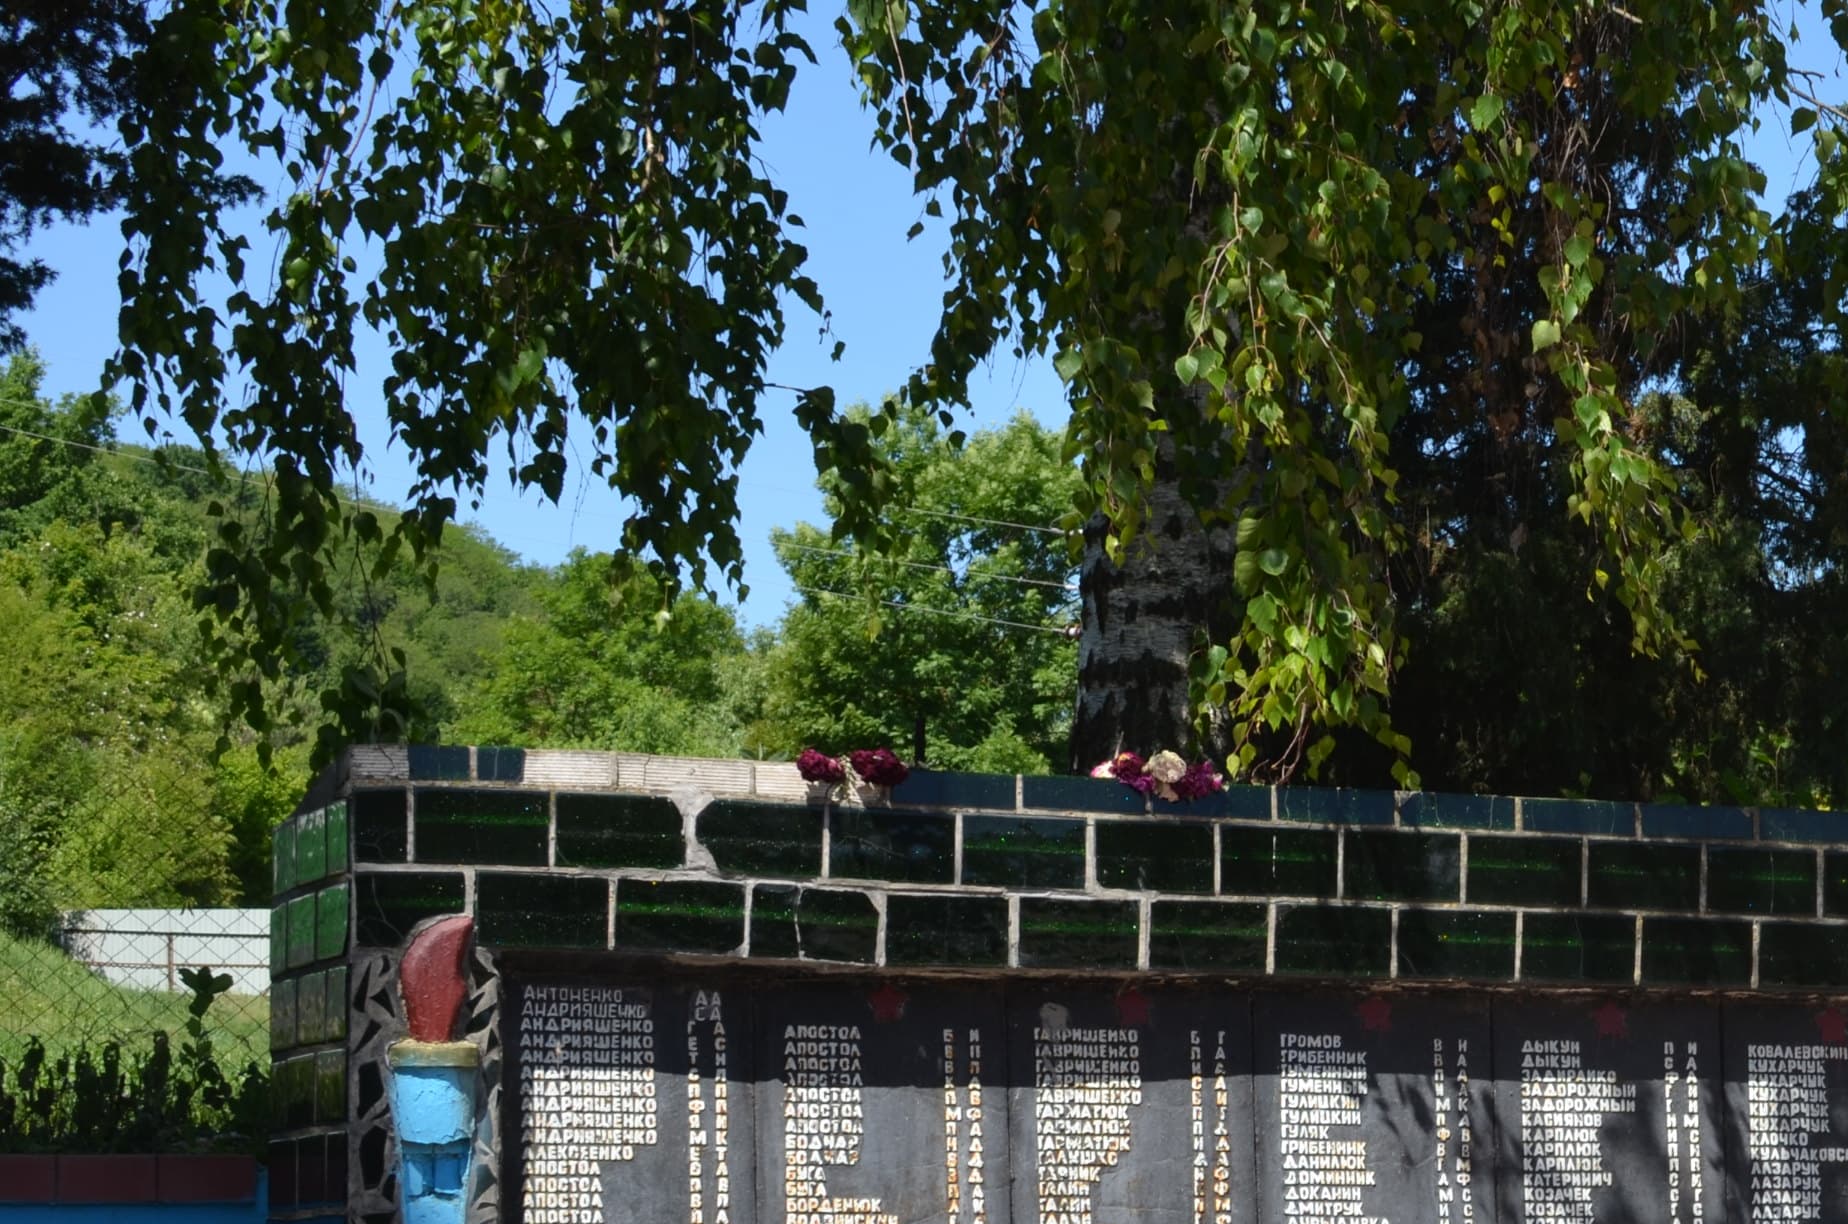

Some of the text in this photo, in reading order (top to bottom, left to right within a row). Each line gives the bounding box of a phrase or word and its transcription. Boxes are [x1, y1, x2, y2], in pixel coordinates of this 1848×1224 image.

[525, 987, 622, 1003] АНТОНЕНКО
[522, 1019, 653, 1034] АНДРИЯШЕНКО
[785, 1024, 860, 1041] АПОСТОЛ
[1281, 1033, 1340, 1049] ГРОМОВ
[1521, 1039, 1579, 1054] ДЫКУН
[785, 1041, 861, 1057] АПОСТОЛ
[522, 1050, 653, 1065] АНДРИЯШЕНКО
[785, 1057, 861, 1072] АПОСТОЛ
[1281, 1049, 1366, 1065] ГРИБЕННИК
[1522, 1054, 1579, 1069] ДЫКУН
[1748, 1061, 1825, 1074] КУХАРЧУК
[1748, 1074, 1825, 1088] КУХАРЧУК
[785, 1087, 862, 1103] АПОСТОЛ
[1748, 1088, 1826, 1102] КУХАРЧУК
[522, 1097, 657, 1113] АНДРИЯШЕНКО
[785, 1103, 863, 1119] АПОСТОЛ
[1749, 1102, 1828, 1118] КУХАРЧУК
[785, 1119, 863, 1134] АПОСТОЛ
[1522, 1113, 1602, 1128] КАСИЯНОВ
[1749, 1118, 1829, 1132] КУХАРЧУК
[1281, 1125, 1328, 1140] ГУЛЯК
[1522, 1128, 1598, 1143] КАРПЛЮК
[1750, 1132, 1808, 1147] КЛОЧКО
[1281, 1140, 1366, 1155] ГРИБЕННИК
[1523, 1143, 1601, 1157] КАРПЛЮК
[523, 1161, 600, 1176] АПОСТОЛ
[1284, 1155, 1365, 1170] ДАНИЛЮК
[1524, 1157, 1602, 1172] КАРПЛЮК
[1751, 1161, 1819, 1176] ЛАЗАРУК
[525, 1176, 602, 1193] АПОСТОЛ
[1285, 1170, 1375, 1186] ДОМИННИК
[1524, 1172, 1612, 1187] КАТЕРИНИЧ
[1752, 1176, 1821, 1190] ЛАЗАРУК
[524, 1193, 602, 1209] АПОСТОЛ
[1285, 1186, 1361, 1201] ДОКАНИН
[1525, 1187, 1591, 1202] КОЗАЧЕК
[1752, 1190, 1820, 1205] ЛАЗАРУК
[1285, 1201, 1362, 1216] ДМИТРУК
[1525, 1202, 1593, 1217] КОЗАЧЕК
[1753, 1205, 1820, 1220] ЛАЗАРУК
[524, 1209, 603, 1224] АПОСТОЛ
